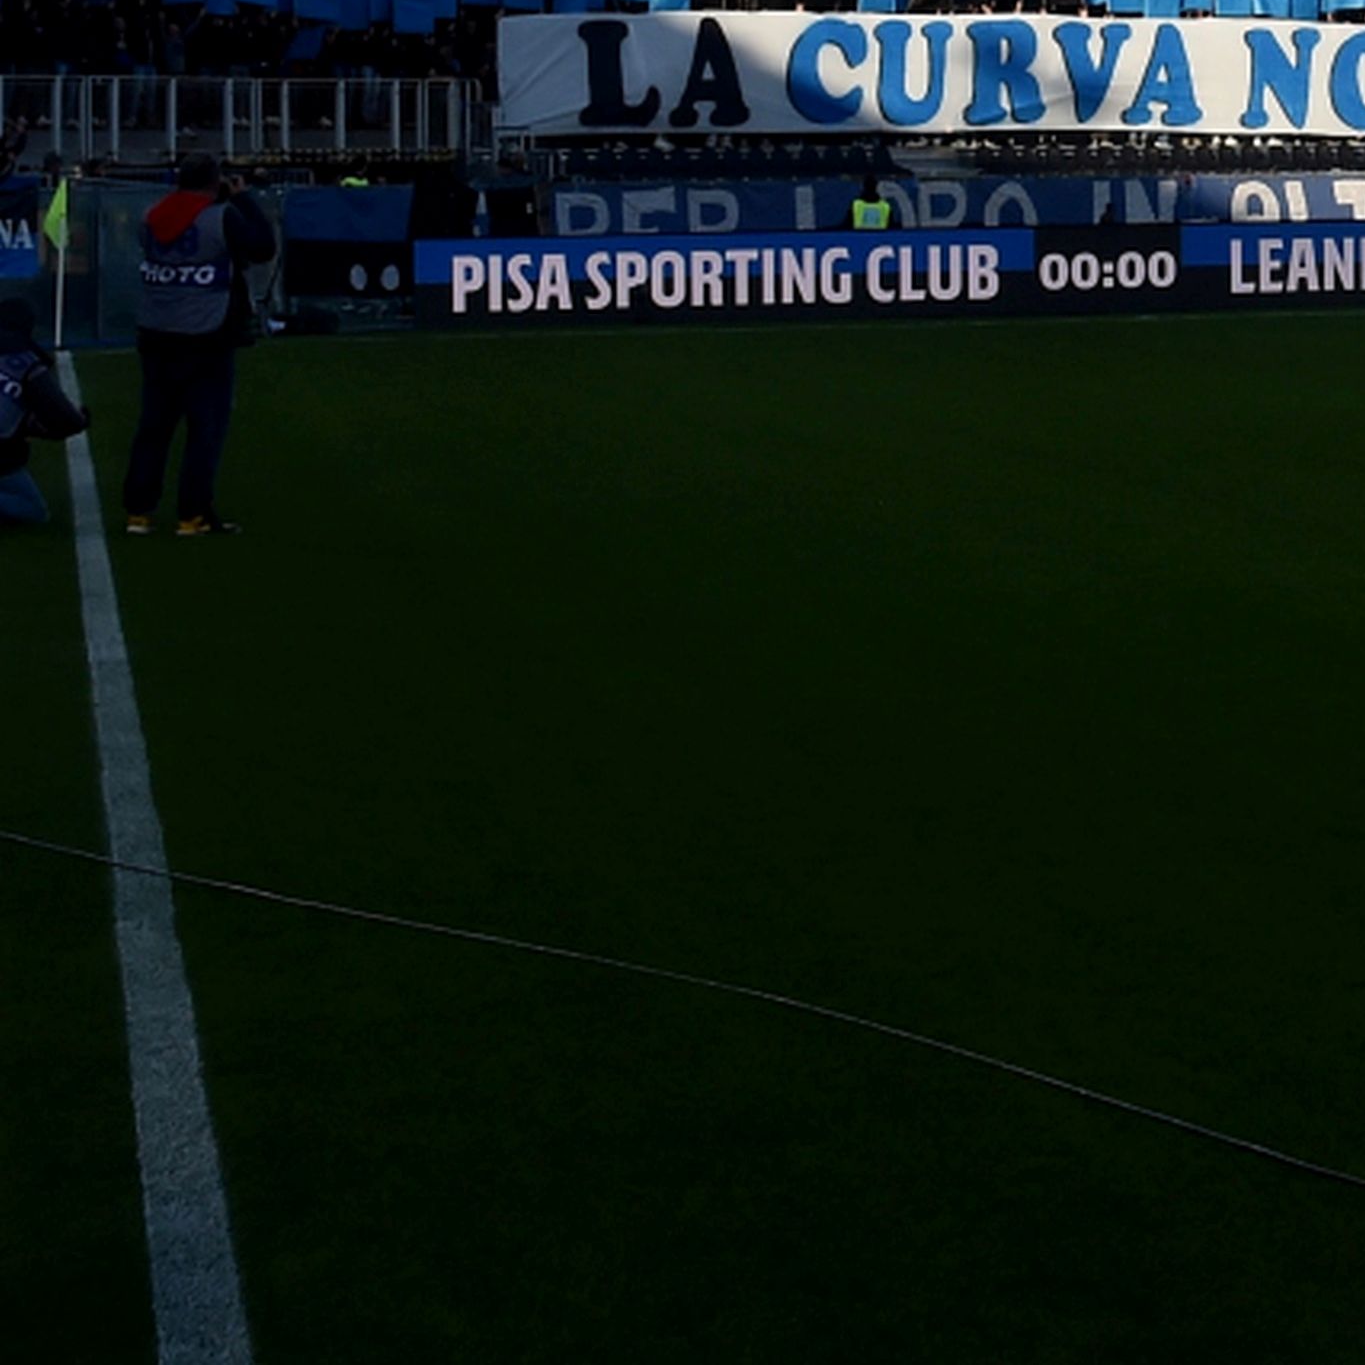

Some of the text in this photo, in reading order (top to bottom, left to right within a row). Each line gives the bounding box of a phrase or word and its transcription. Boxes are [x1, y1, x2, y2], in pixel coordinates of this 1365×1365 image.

[578, 18, 749, 126] LA
[787, 18, 1202, 126] CURVA
[451, 244, 1001, 314] PISA SPORTING CLUB
[1038, 251, 1178, 292] 00:00
